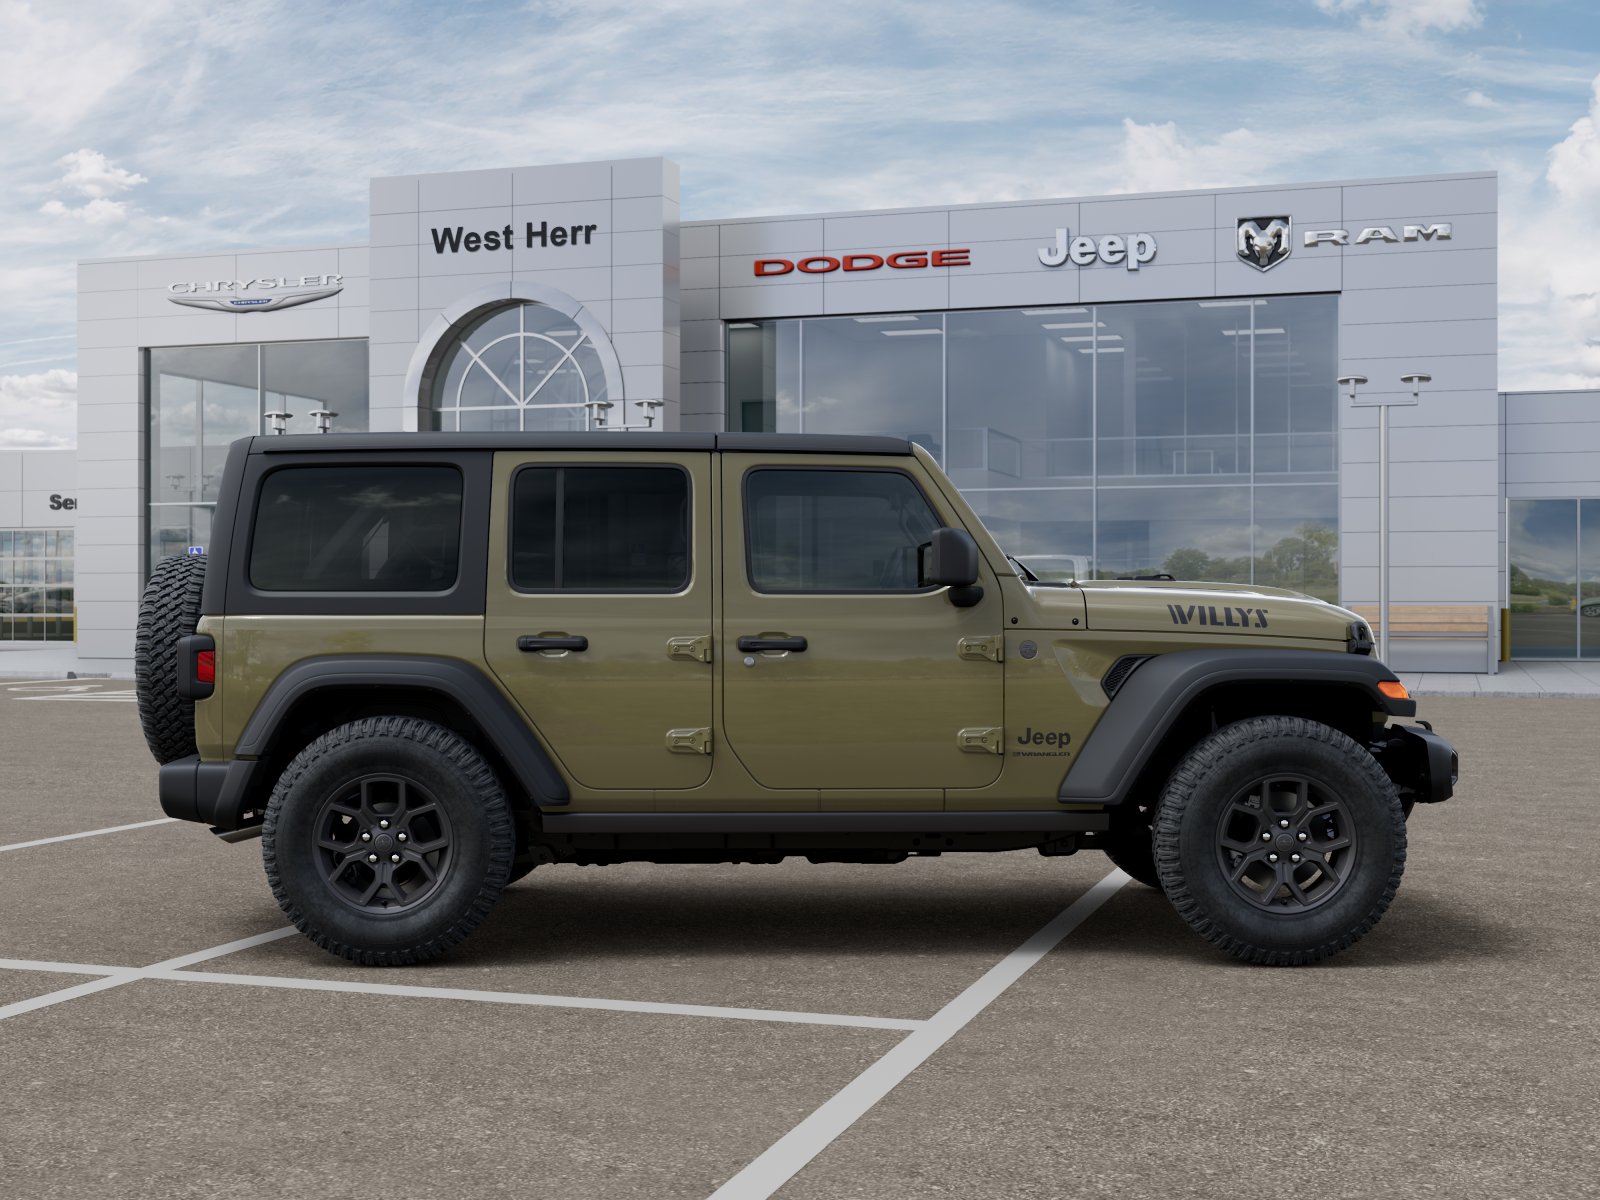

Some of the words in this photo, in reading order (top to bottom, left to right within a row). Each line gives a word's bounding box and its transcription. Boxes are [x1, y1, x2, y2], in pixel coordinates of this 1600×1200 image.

[431, 224, 514, 254] West
[526, 221, 597, 248] Herr
[1304, 223, 1452, 248] RAM
[1038, 227, 1157, 271] Jeep
[754, 249, 971, 276] DODGE
[168, 273, 343, 293] CHRYSLER
[1167, 604, 1269, 628] WILLYS
[1017, 727, 1071, 748] Jeep
